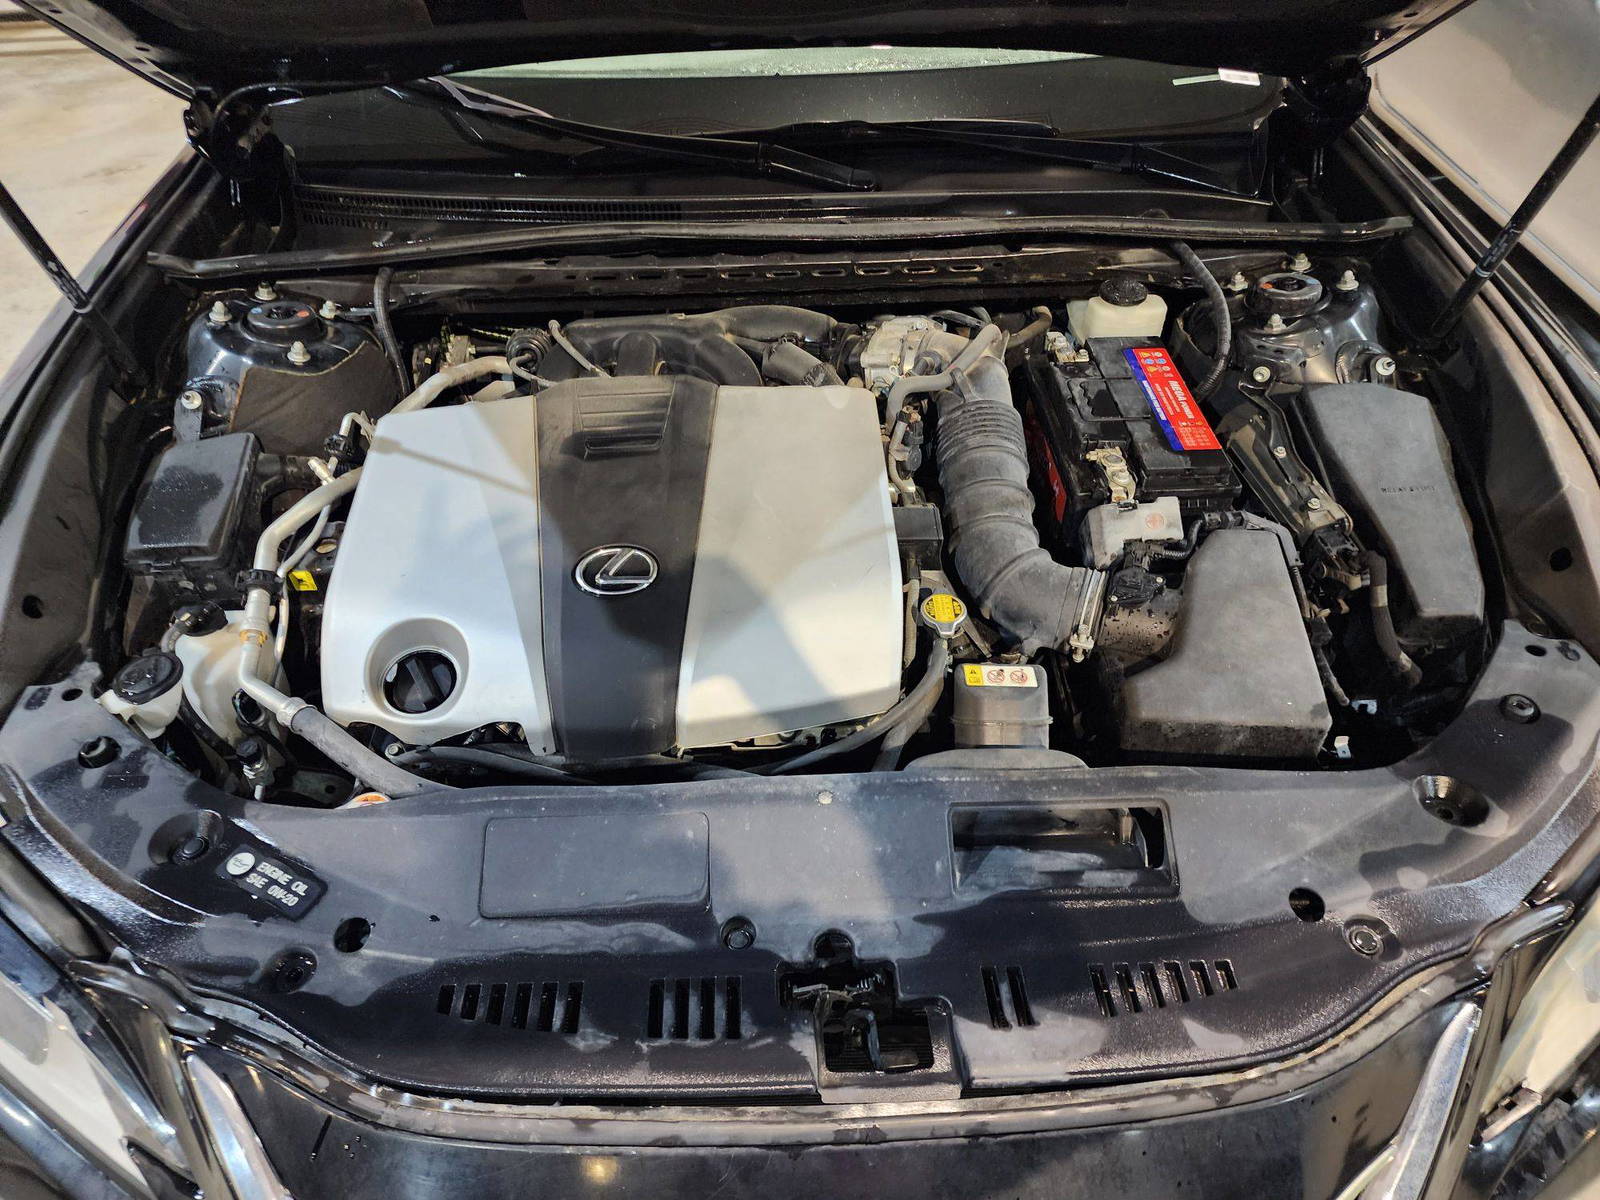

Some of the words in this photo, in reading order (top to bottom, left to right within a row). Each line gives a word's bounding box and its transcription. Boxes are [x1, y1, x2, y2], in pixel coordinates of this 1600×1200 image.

[1168, 380, 1187, 401] MEGA
[246, 873, 269, 888] SAE
[256, 862, 293, 885] ENGINE
[291, 881, 308, 896] OIL
